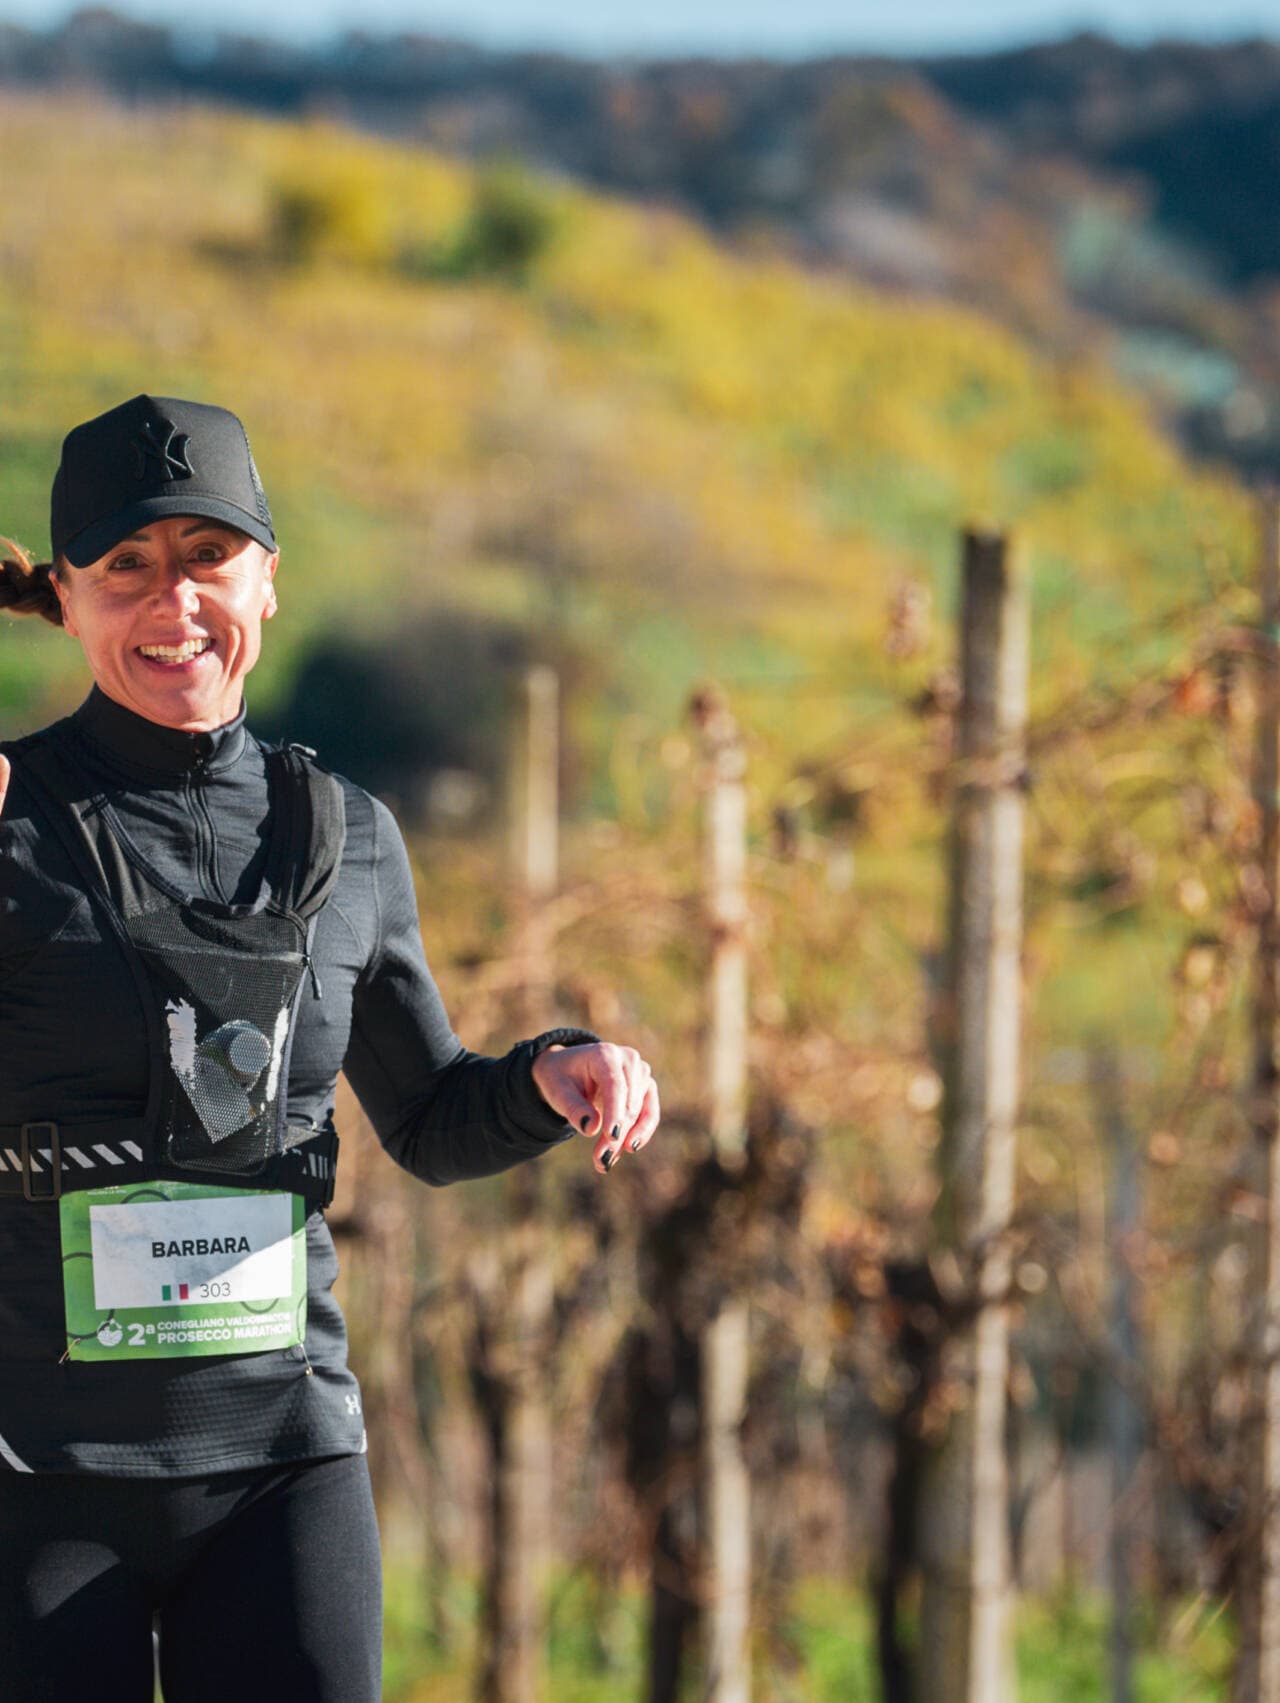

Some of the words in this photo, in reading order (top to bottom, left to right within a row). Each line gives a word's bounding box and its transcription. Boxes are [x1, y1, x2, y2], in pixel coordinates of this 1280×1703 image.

[151, 1236, 251, 1258] BARBARA
[199, 1282, 231, 1298] 303
[157, 1318, 225, 1331] CONEGLIANO
[157, 1329, 232, 1344] PROSECCO
[234, 1323, 292, 1339] MARATHON
